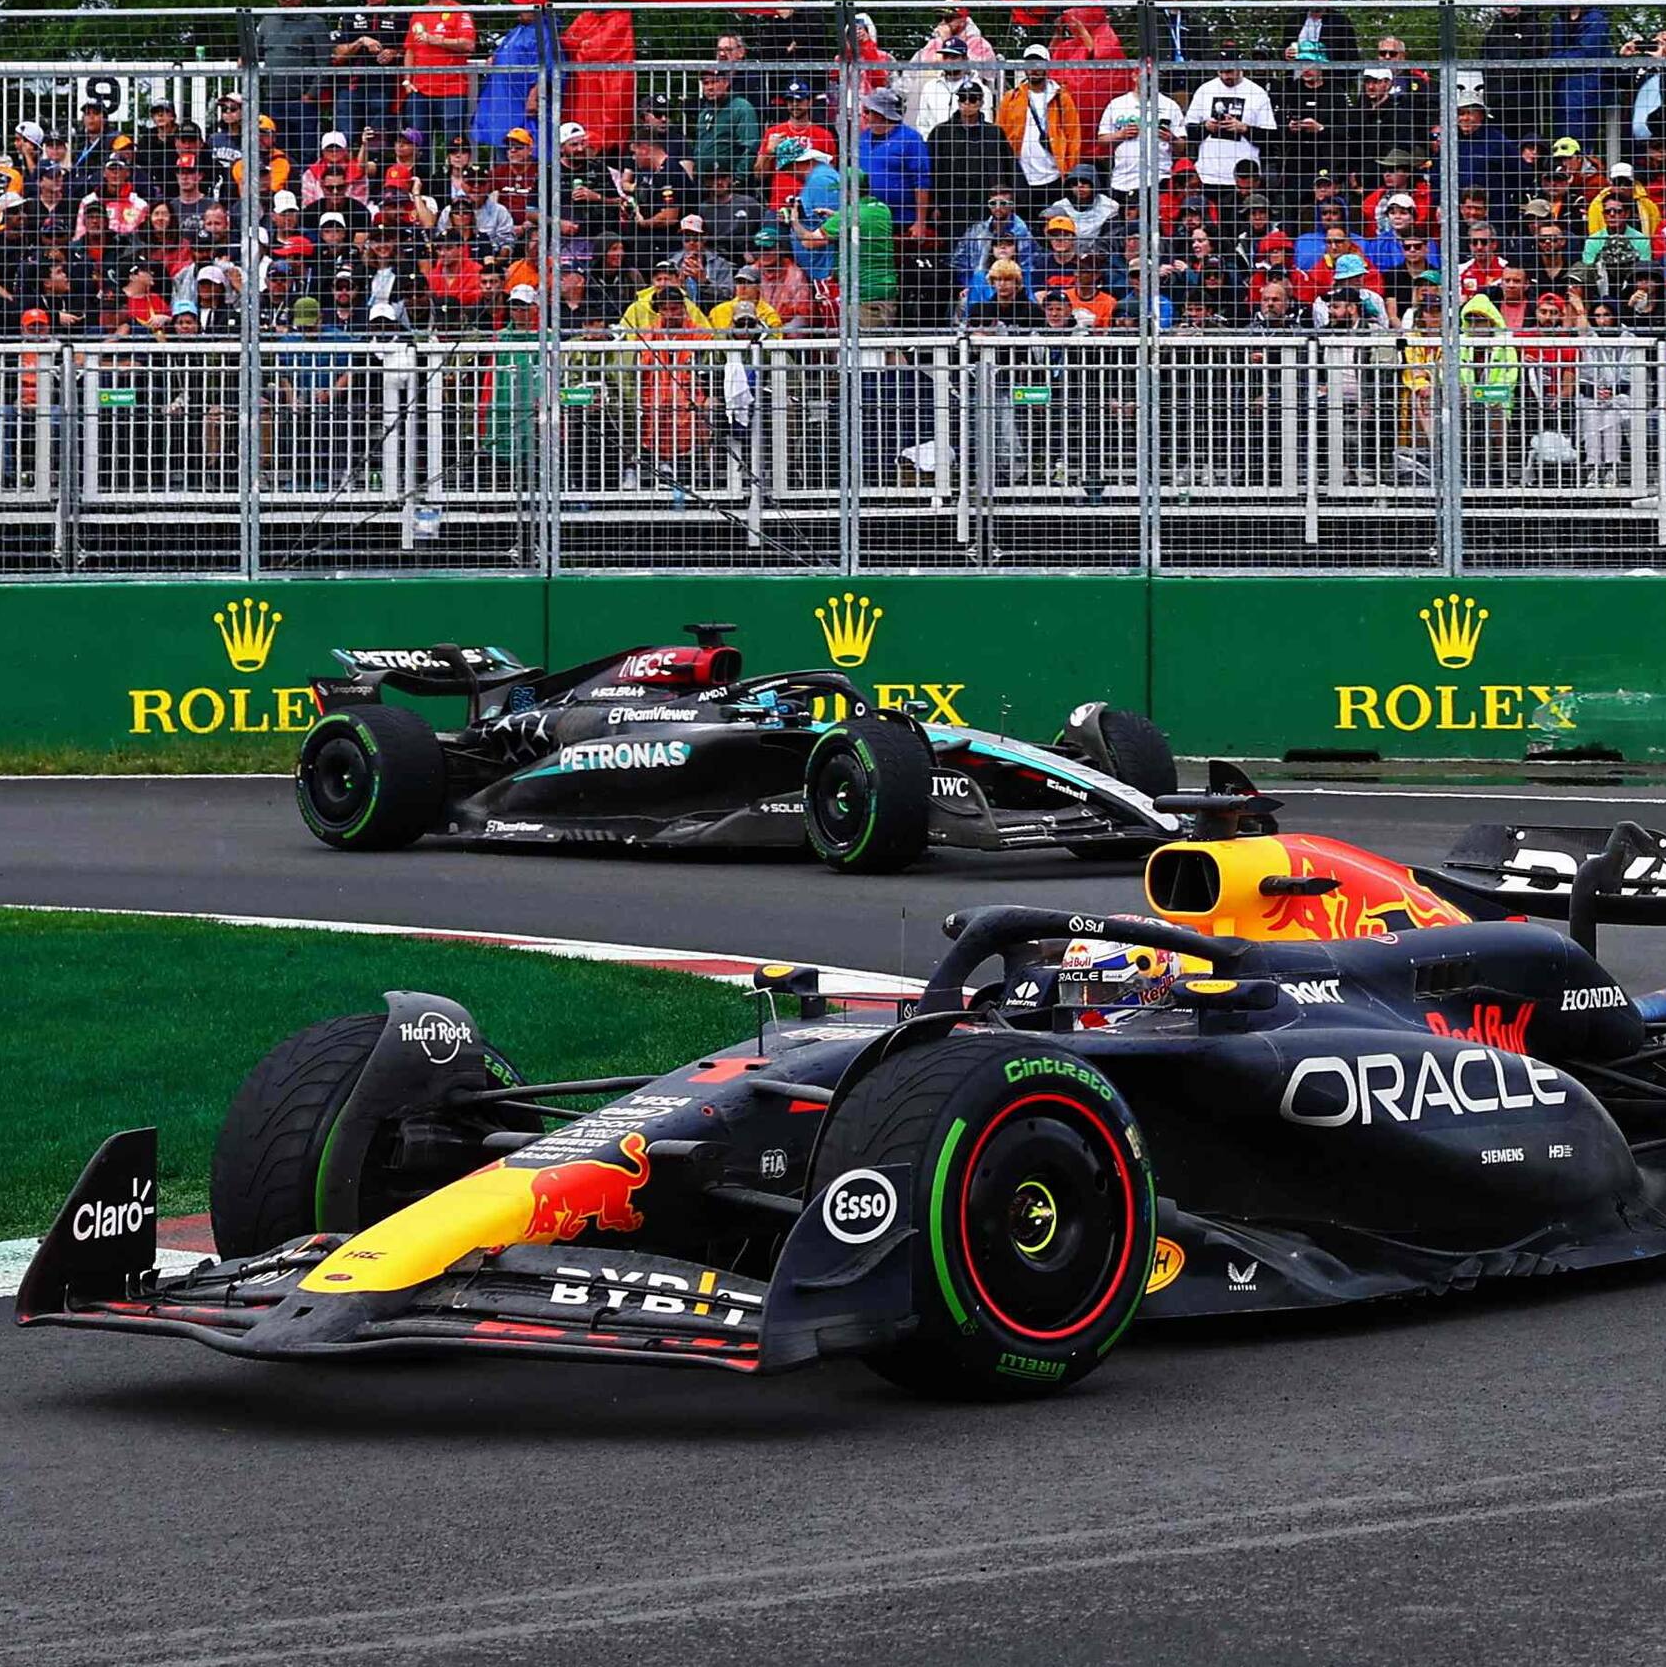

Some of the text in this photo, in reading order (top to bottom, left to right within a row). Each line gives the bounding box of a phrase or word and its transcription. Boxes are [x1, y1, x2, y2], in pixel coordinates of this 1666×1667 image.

[87, 77, 121, 115] 9
[353, 649, 483, 669] PETROS
[619, 653, 676, 677] INEOS
[128, 687, 316, 734] ROLE
[623, 706, 698, 721] TeamViewer
[1334, 684, 1577, 731] ROLEX
[559, 741, 687, 770] PETRONAS
[931, 776, 970, 798] IWC
[1046, 779, 1088, 802] Einhell
[1280, 979, 1347, 1005] ROKT
[1561, 986, 1627, 1011] HONDA
[398, 1021, 473, 1045] Hard Rock
[1004, 1056, 1115, 1102] Cinturato
[1279, 1049, 1567, 1127] ORACLE
[630, 1095, 692, 1106] VISA
[575, 1119, 646, 1129] zoom
[761, 1153, 787, 1176] FIA
[1481, 1147, 1525, 1165] SIEMENS
[73, 1193, 144, 1241] Claro
[835, 1189, 886, 1221] Esso
[549, 1267, 763, 1325] BYBIT
